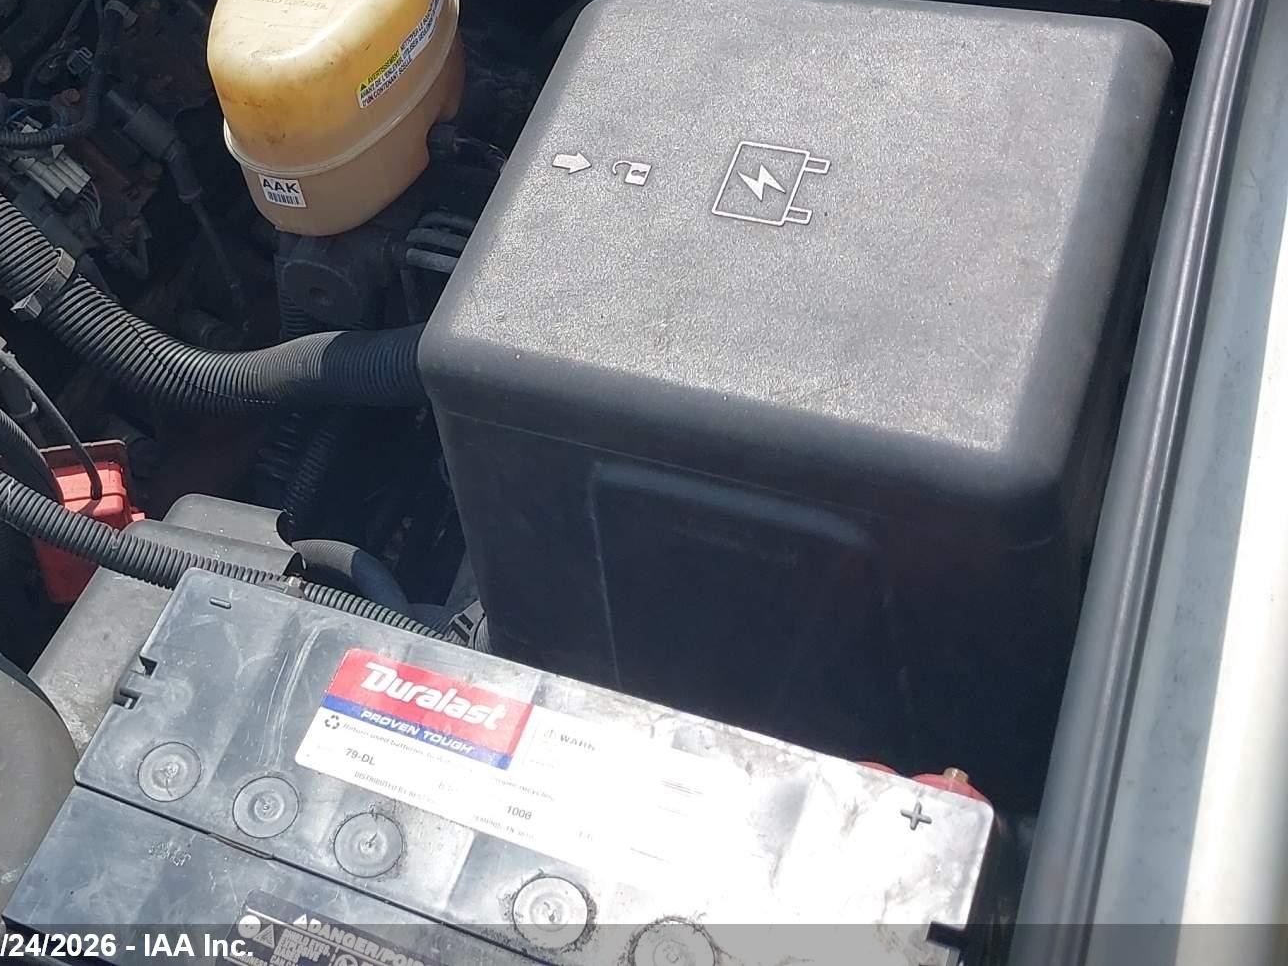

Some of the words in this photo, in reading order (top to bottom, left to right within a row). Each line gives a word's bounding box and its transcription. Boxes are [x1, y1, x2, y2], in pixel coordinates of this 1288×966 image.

[263, 178, 300, 194] AAK
[361, 662, 509, 731] Duralast
[360, 710, 421, 736] PROVEN
[423, 728, 476, 755] TOUGH
[345, 747, 376, 766] 79-DL
